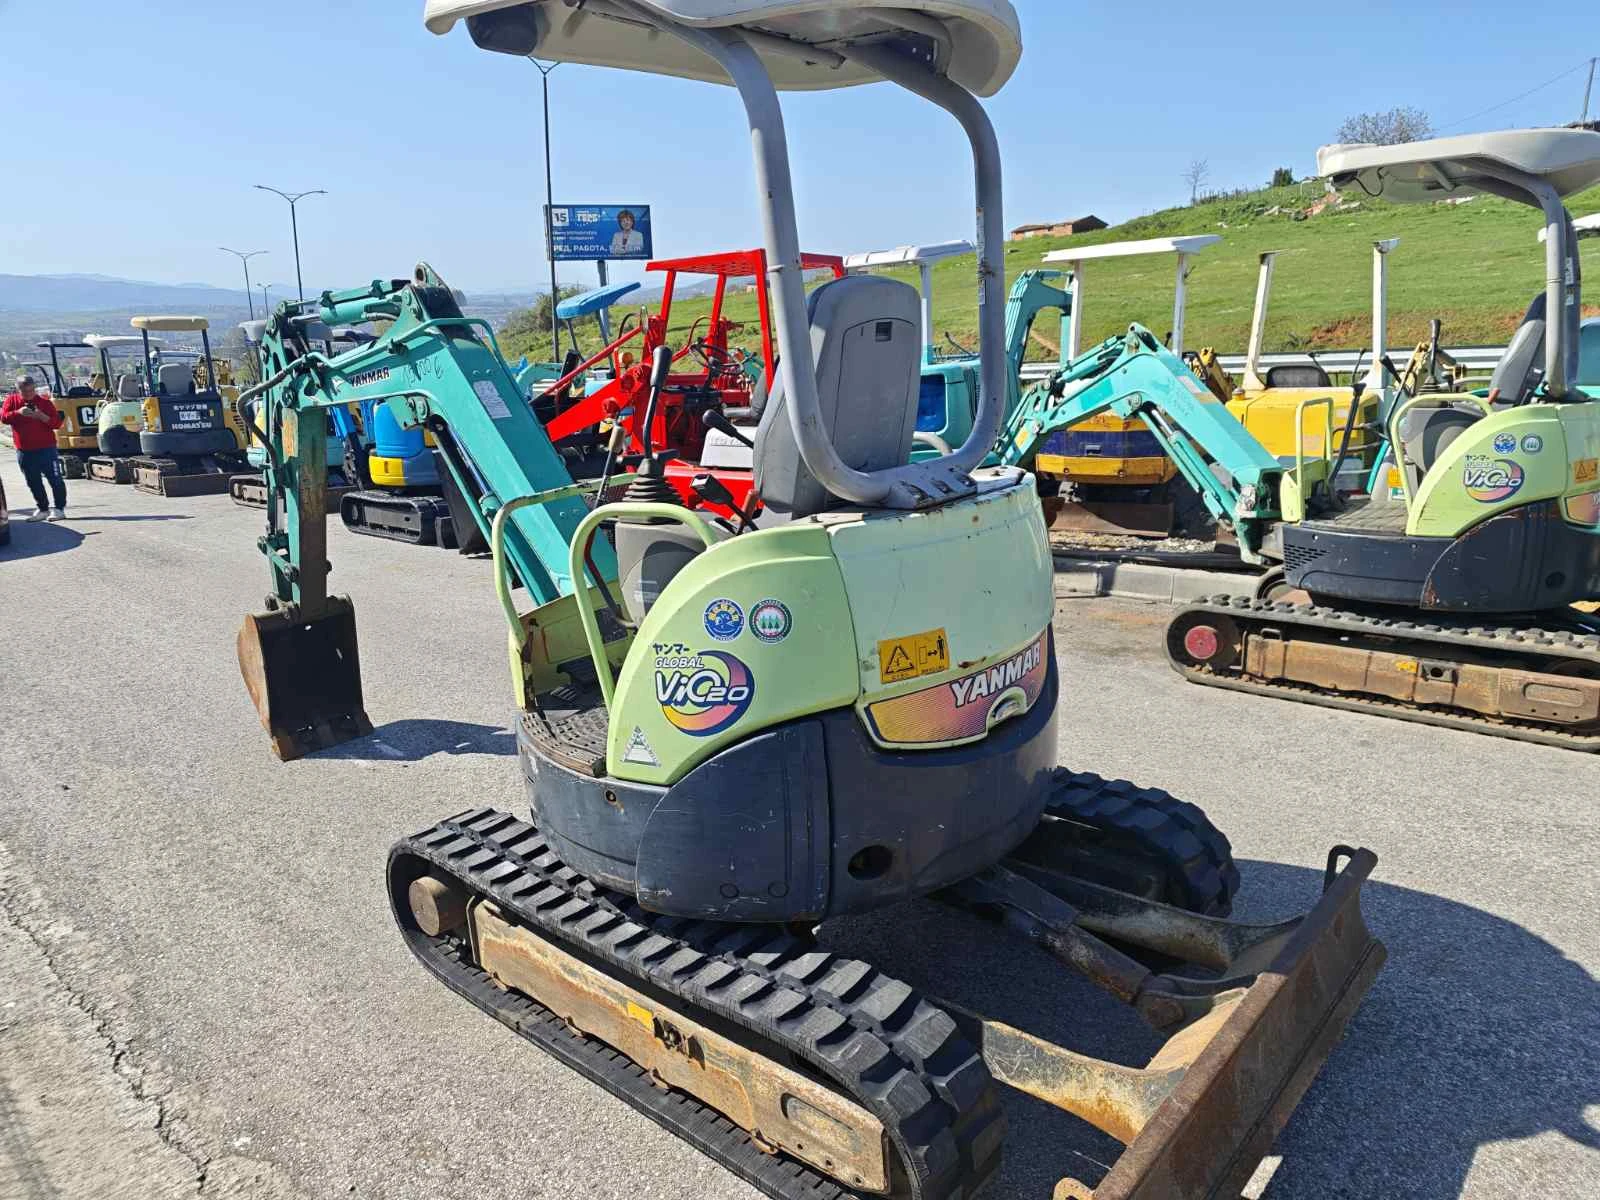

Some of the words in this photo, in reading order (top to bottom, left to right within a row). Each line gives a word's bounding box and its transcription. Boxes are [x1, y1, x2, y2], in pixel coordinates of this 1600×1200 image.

[554, 213, 567, 222] 15
[348, 366, 390, 387] YANMAR
[171, 422, 212, 430] KOMATSU
[653, 643, 690, 655] ヤンマー
[655, 656, 705, 669] GLOBAL
[951, 641, 1040, 709] YANMAR
